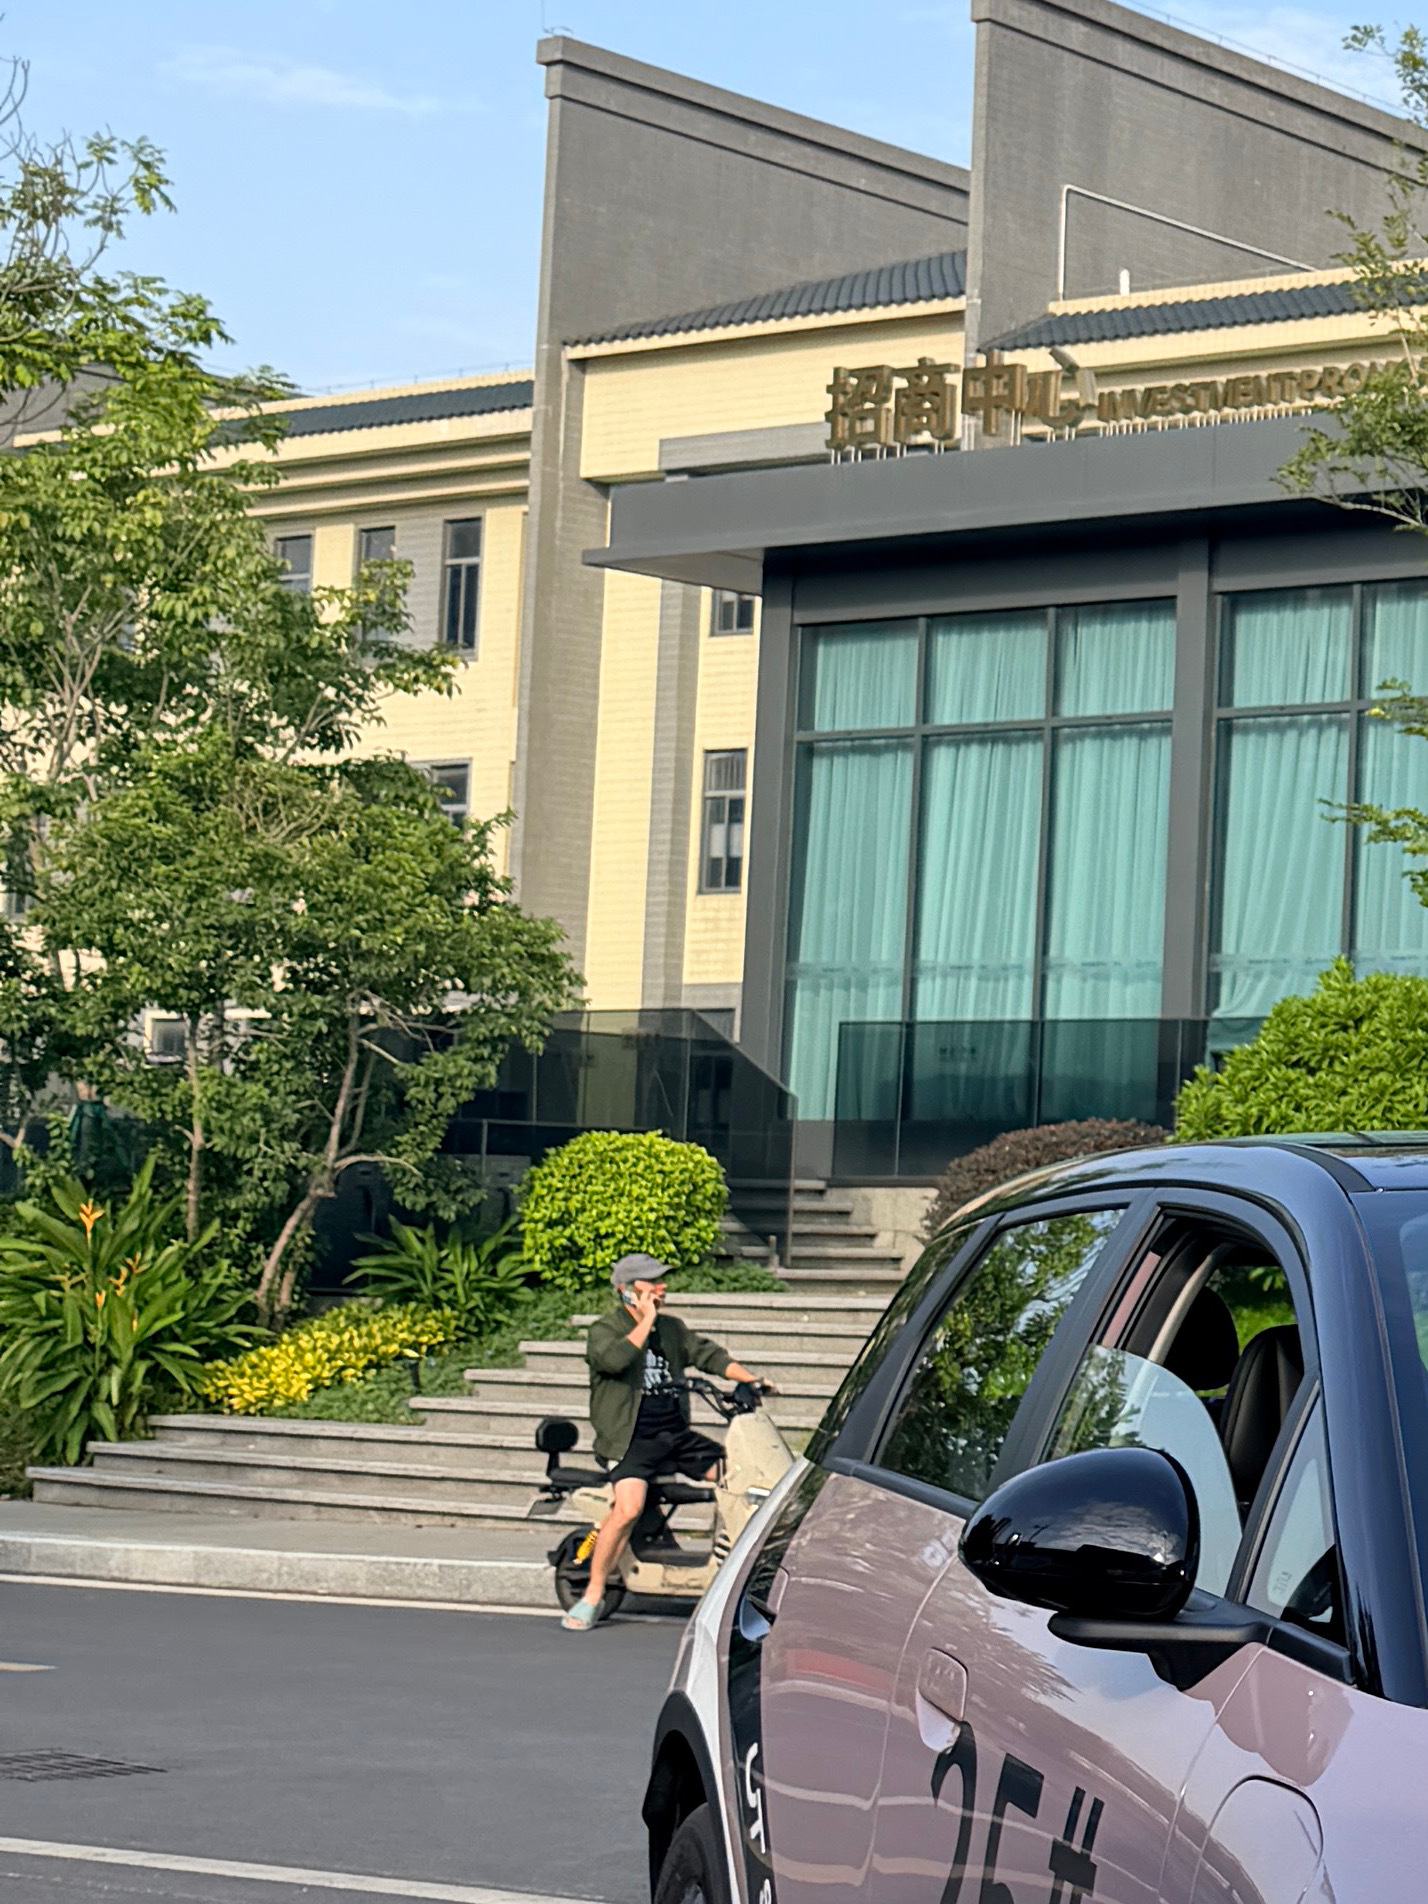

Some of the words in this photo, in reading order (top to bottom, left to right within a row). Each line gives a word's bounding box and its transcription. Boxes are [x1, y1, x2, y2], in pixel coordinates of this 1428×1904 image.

[825, 347, 1098, 445] 招商中心
[1098, 369, 1298, 422] INVESTMENT
